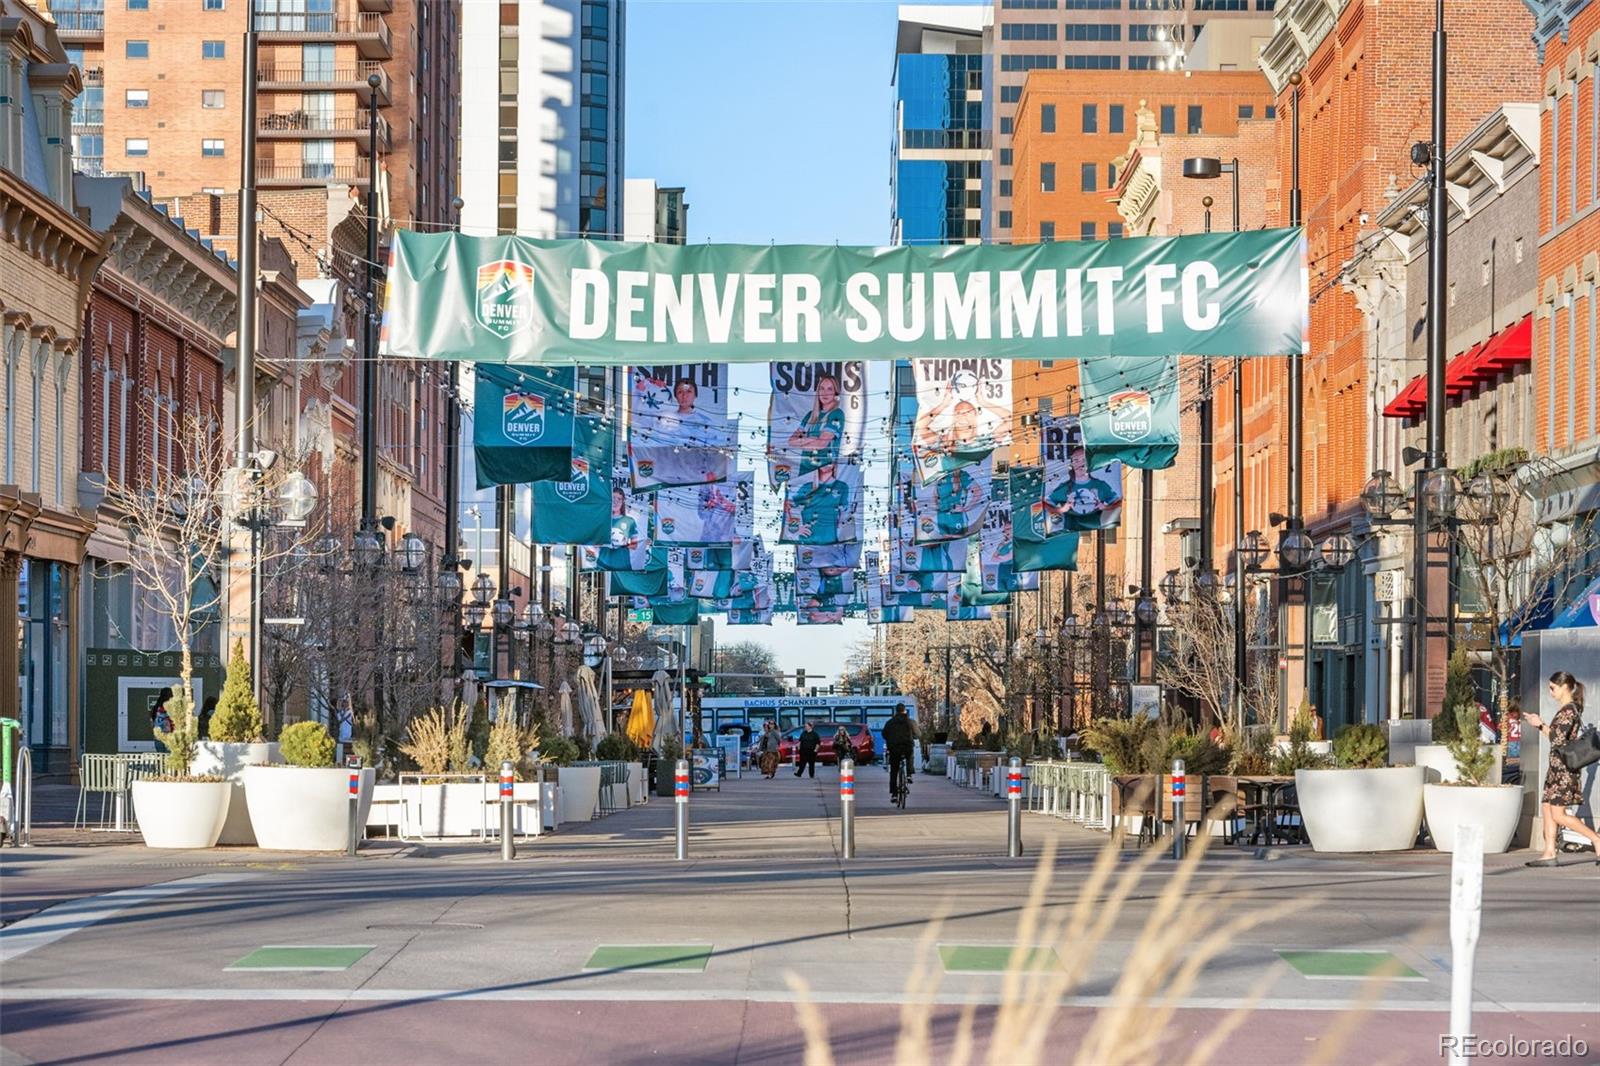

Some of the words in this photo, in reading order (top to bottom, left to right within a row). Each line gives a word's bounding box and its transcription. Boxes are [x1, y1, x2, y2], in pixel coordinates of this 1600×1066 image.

[569, 268, 822, 343] DENVER
[845, 266, 1123, 343] SUMMIT
[1146, 261, 1221, 333] FC
[482, 303, 527, 318] DENVER
[775, 362, 862, 392] SONIS
[919, 359, 1003, 381] THOMAS
[712, 388, 719, 403] 1
[986, 384, 1003, 399] 33
[850, 395, 858, 409] 6
[507, 422, 540, 433] DENVER
[1114, 420, 1147, 431] DENVER
[558, 483, 586, 492] DENVER
[1510, 723, 1521, 738] 2
